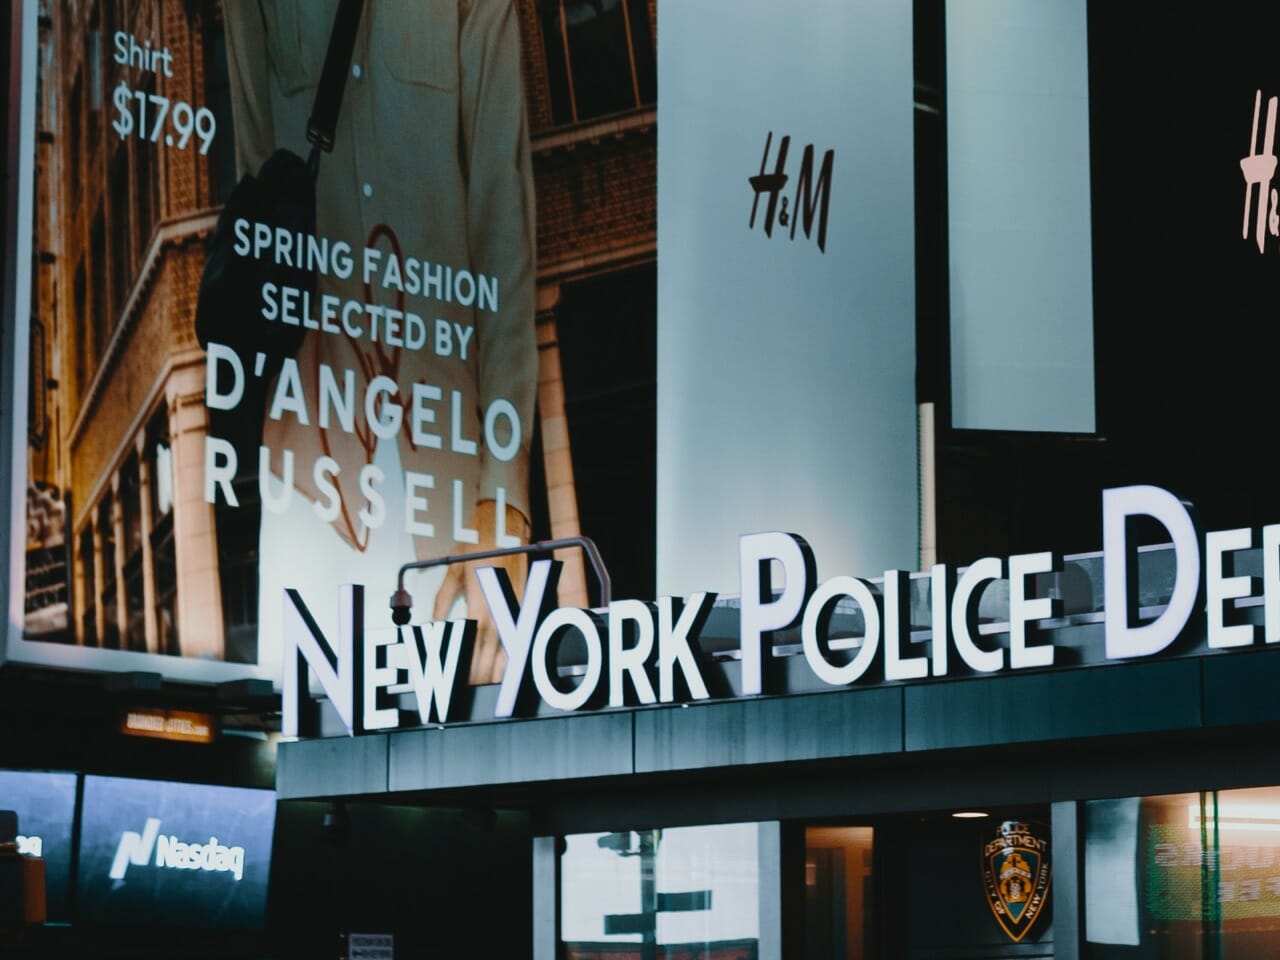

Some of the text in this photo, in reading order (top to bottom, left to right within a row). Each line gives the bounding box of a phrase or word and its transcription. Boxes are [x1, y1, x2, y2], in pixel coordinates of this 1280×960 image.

[113, 31, 174, 78] Shirt
[111, 80, 217, 156] $17.99
[748, 131, 834, 254] H&M
[233, 217, 499, 313] SPRING FASHION
[261, 282, 474, 360] SELECTED BY
[205, 342, 521, 462] D'ANGELO
[205, 436, 522, 548] RUSSELL
[475, 559, 711, 718] YORK
[739, 531, 1056, 695] POLICE
[155, 834, 245, 882] Nasdaq
[984, 835, 1047, 857] DEPARTMENT
[1024, 894, 1042, 920] NEW
